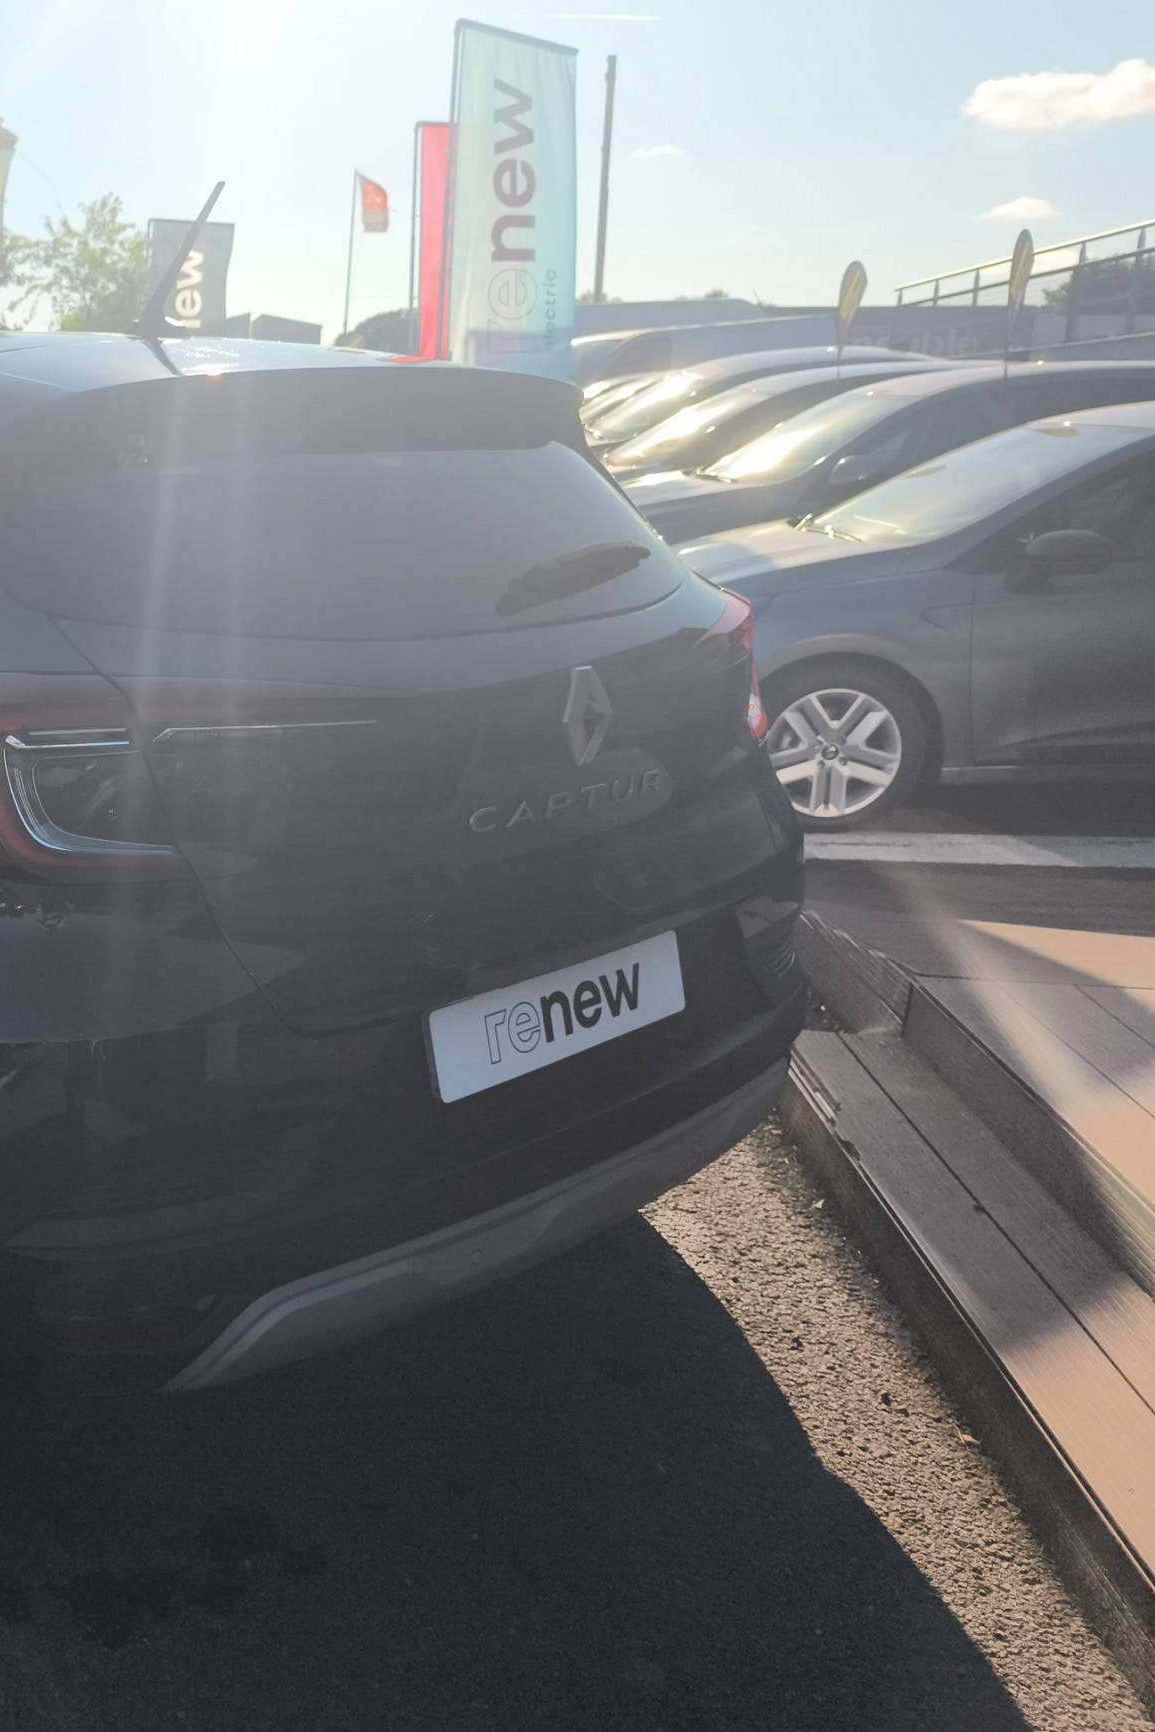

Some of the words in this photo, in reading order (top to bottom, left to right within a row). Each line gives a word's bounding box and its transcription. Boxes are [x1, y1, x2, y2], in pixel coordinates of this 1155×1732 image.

[487, 76, 537, 354] renew
[467, 767, 665, 833] CAPTUR
[484, 963, 640, 1065] renew
